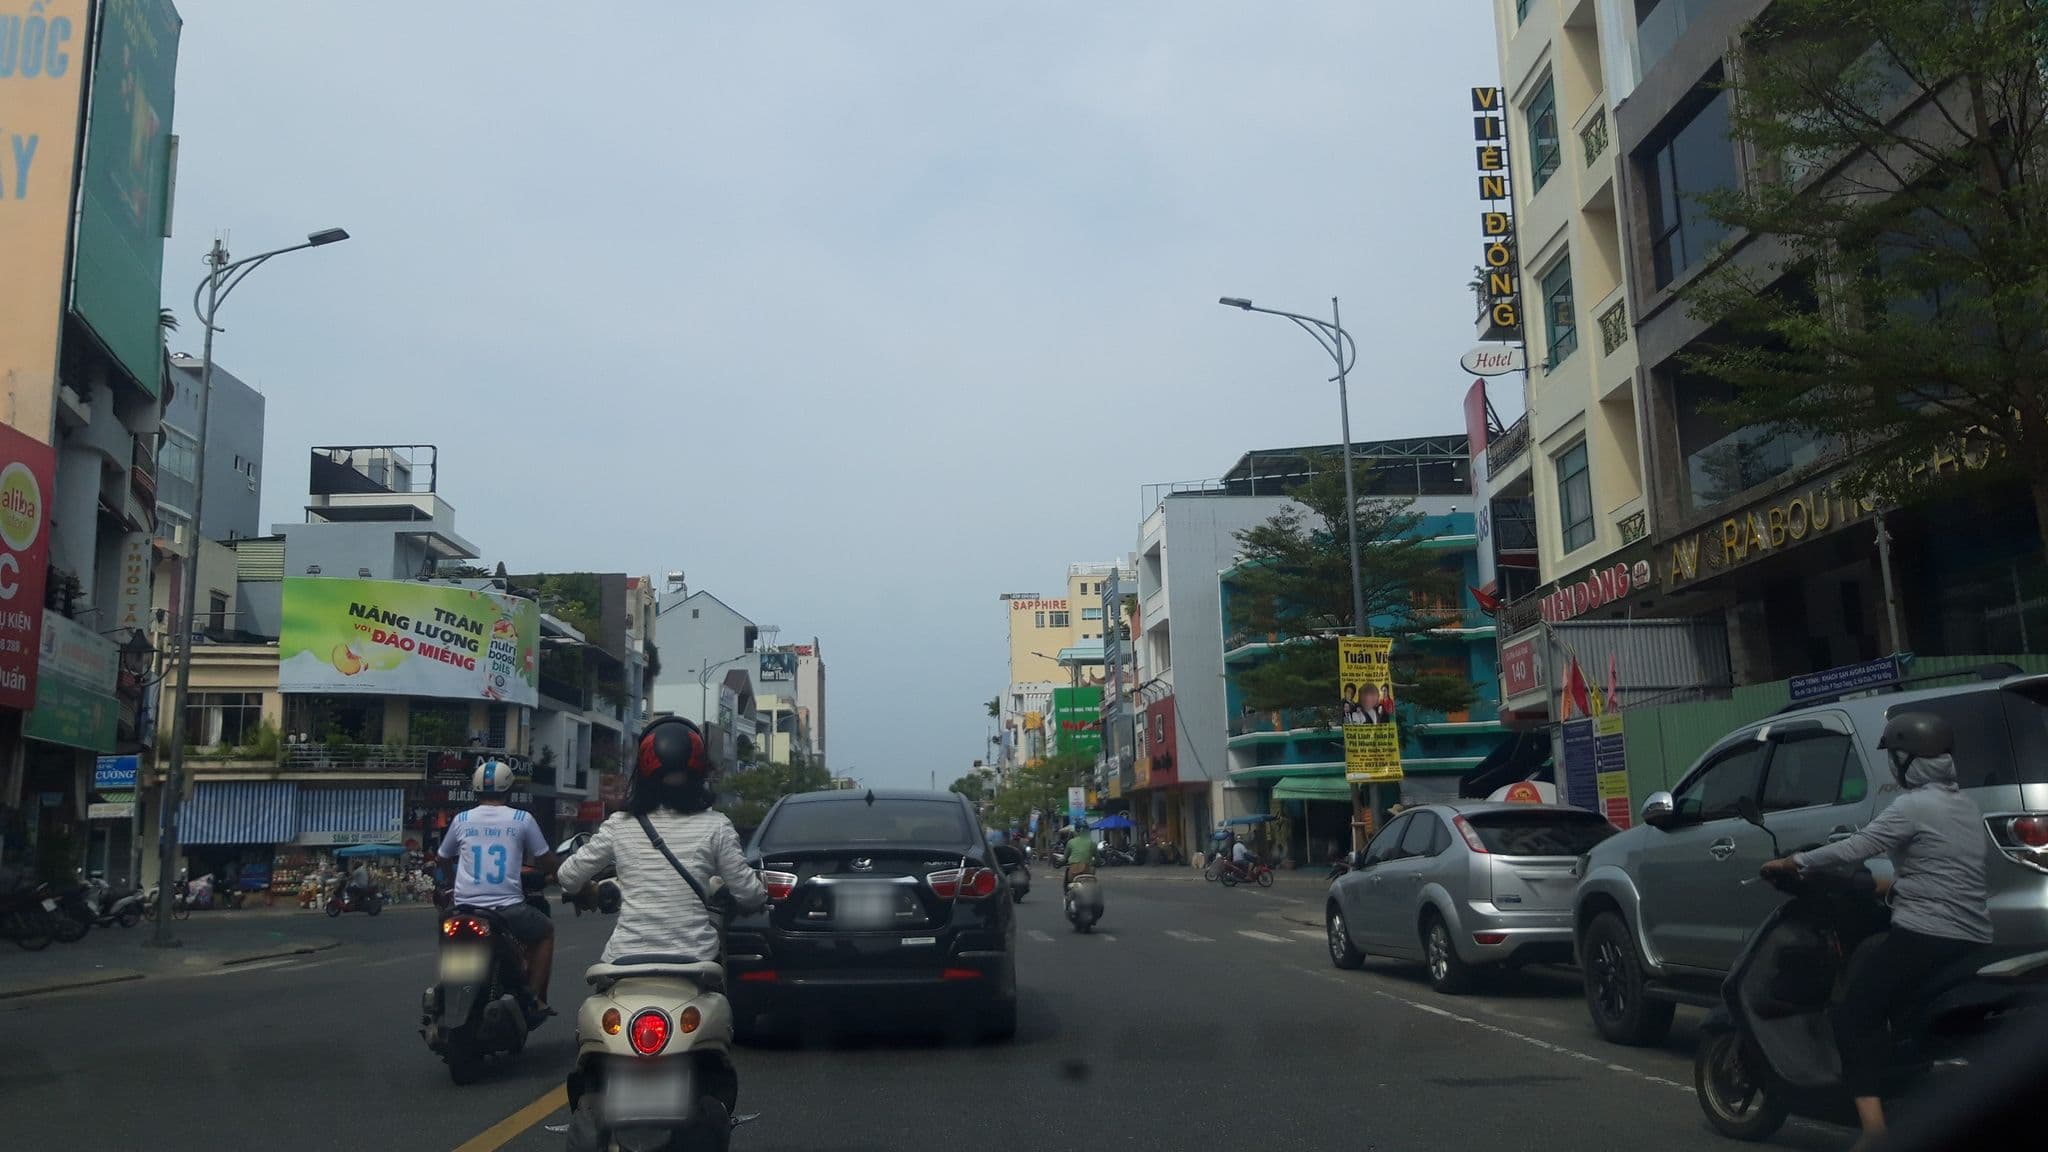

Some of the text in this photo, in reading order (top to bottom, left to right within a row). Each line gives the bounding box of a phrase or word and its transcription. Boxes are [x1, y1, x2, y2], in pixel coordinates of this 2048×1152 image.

[1474, 351, 1513, 369] Hotel
[1012, 599, 1068, 611] SAPPHIRE
[8, 611, 31, 633] KIỆN
[348, 602, 480, 654] NĂNG LƯỢNG
[434, 607, 484, 636] TRÀN
[371, 629, 416, 653] ĐÀO
[418, 643, 476, 672] MIẾNG
[490, 640, 517, 655] nutri
[1344, 649, 1371, 663] Tuấn
[488, 650, 516, 667] boost
[492, 660, 511, 676] bits
[1512, 661, 1526, 682] 140
[471, 844, 506, 884] 13
